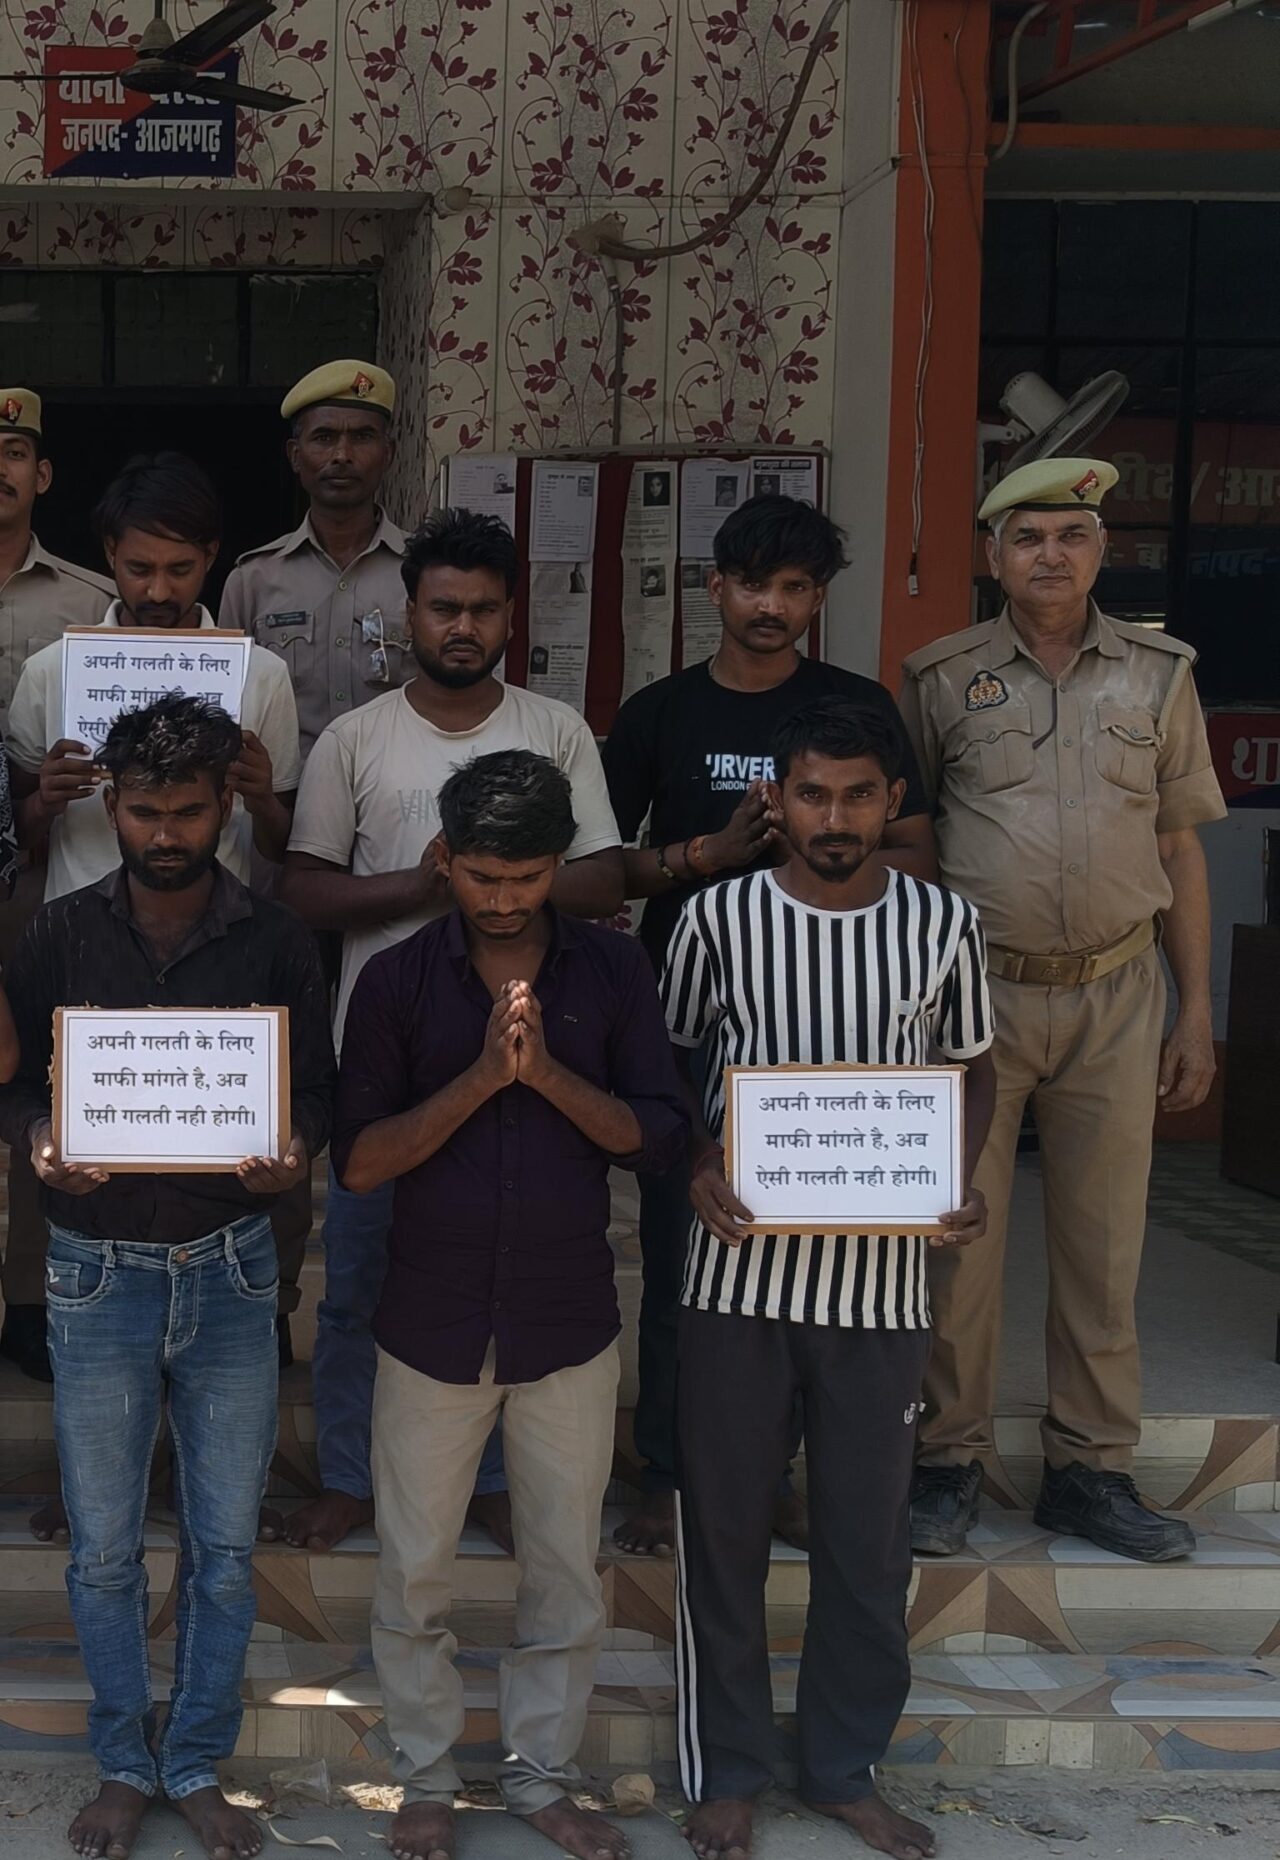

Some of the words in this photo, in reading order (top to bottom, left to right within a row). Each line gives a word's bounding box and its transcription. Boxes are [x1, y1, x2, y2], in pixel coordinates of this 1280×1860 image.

[135, 118, 222, 161] आजमगढ़
[83, 652, 127, 669] अपनी
[130, 653, 175, 670] गलती
[179, 653, 195, 671] के
[198, 653, 231, 675] लिए
[86, 684, 126, 702] माफी
[77, 715, 108, 738] ऐसी
[711, 781, 746, 791] LONDON
[87, 1031, 136, 1050] अपनी
[141, 1031, 190, 1051] गलती
[195, 1030, 213, 1050] के
[217, 1030, 254, 1054] लिए
[92, 1067, 138, 1087] माफी
[142, 1067, 188, 1088] मांगते
[216, 1072, 248, 1088] अब
[758, 1092, 810, 1112] अपनी
[815, 1091, 867, 1111] गलती
[872, 1090, 892, 1111] के
[897, 1089, 935, 1113] लिए
[83, 1103, 117, 1127] ऐसी
[121, 1104, 171, 1125] गलती
[176, 1105, 207, 1126] नही
[212, 1105, 255, 1127] होगी।
[765, 1128, 812, 1148] माफी
[817, 1128, 866, 1148] मांगते
[895, 1132, 929, 1148] अब
[756, 1165, 791, 1189] ऐसी
[796, 1165, 848, 1186] गलती
[853, 1165, 886, 1187] नही
[891, 1164, 937, 1187] होगी।
